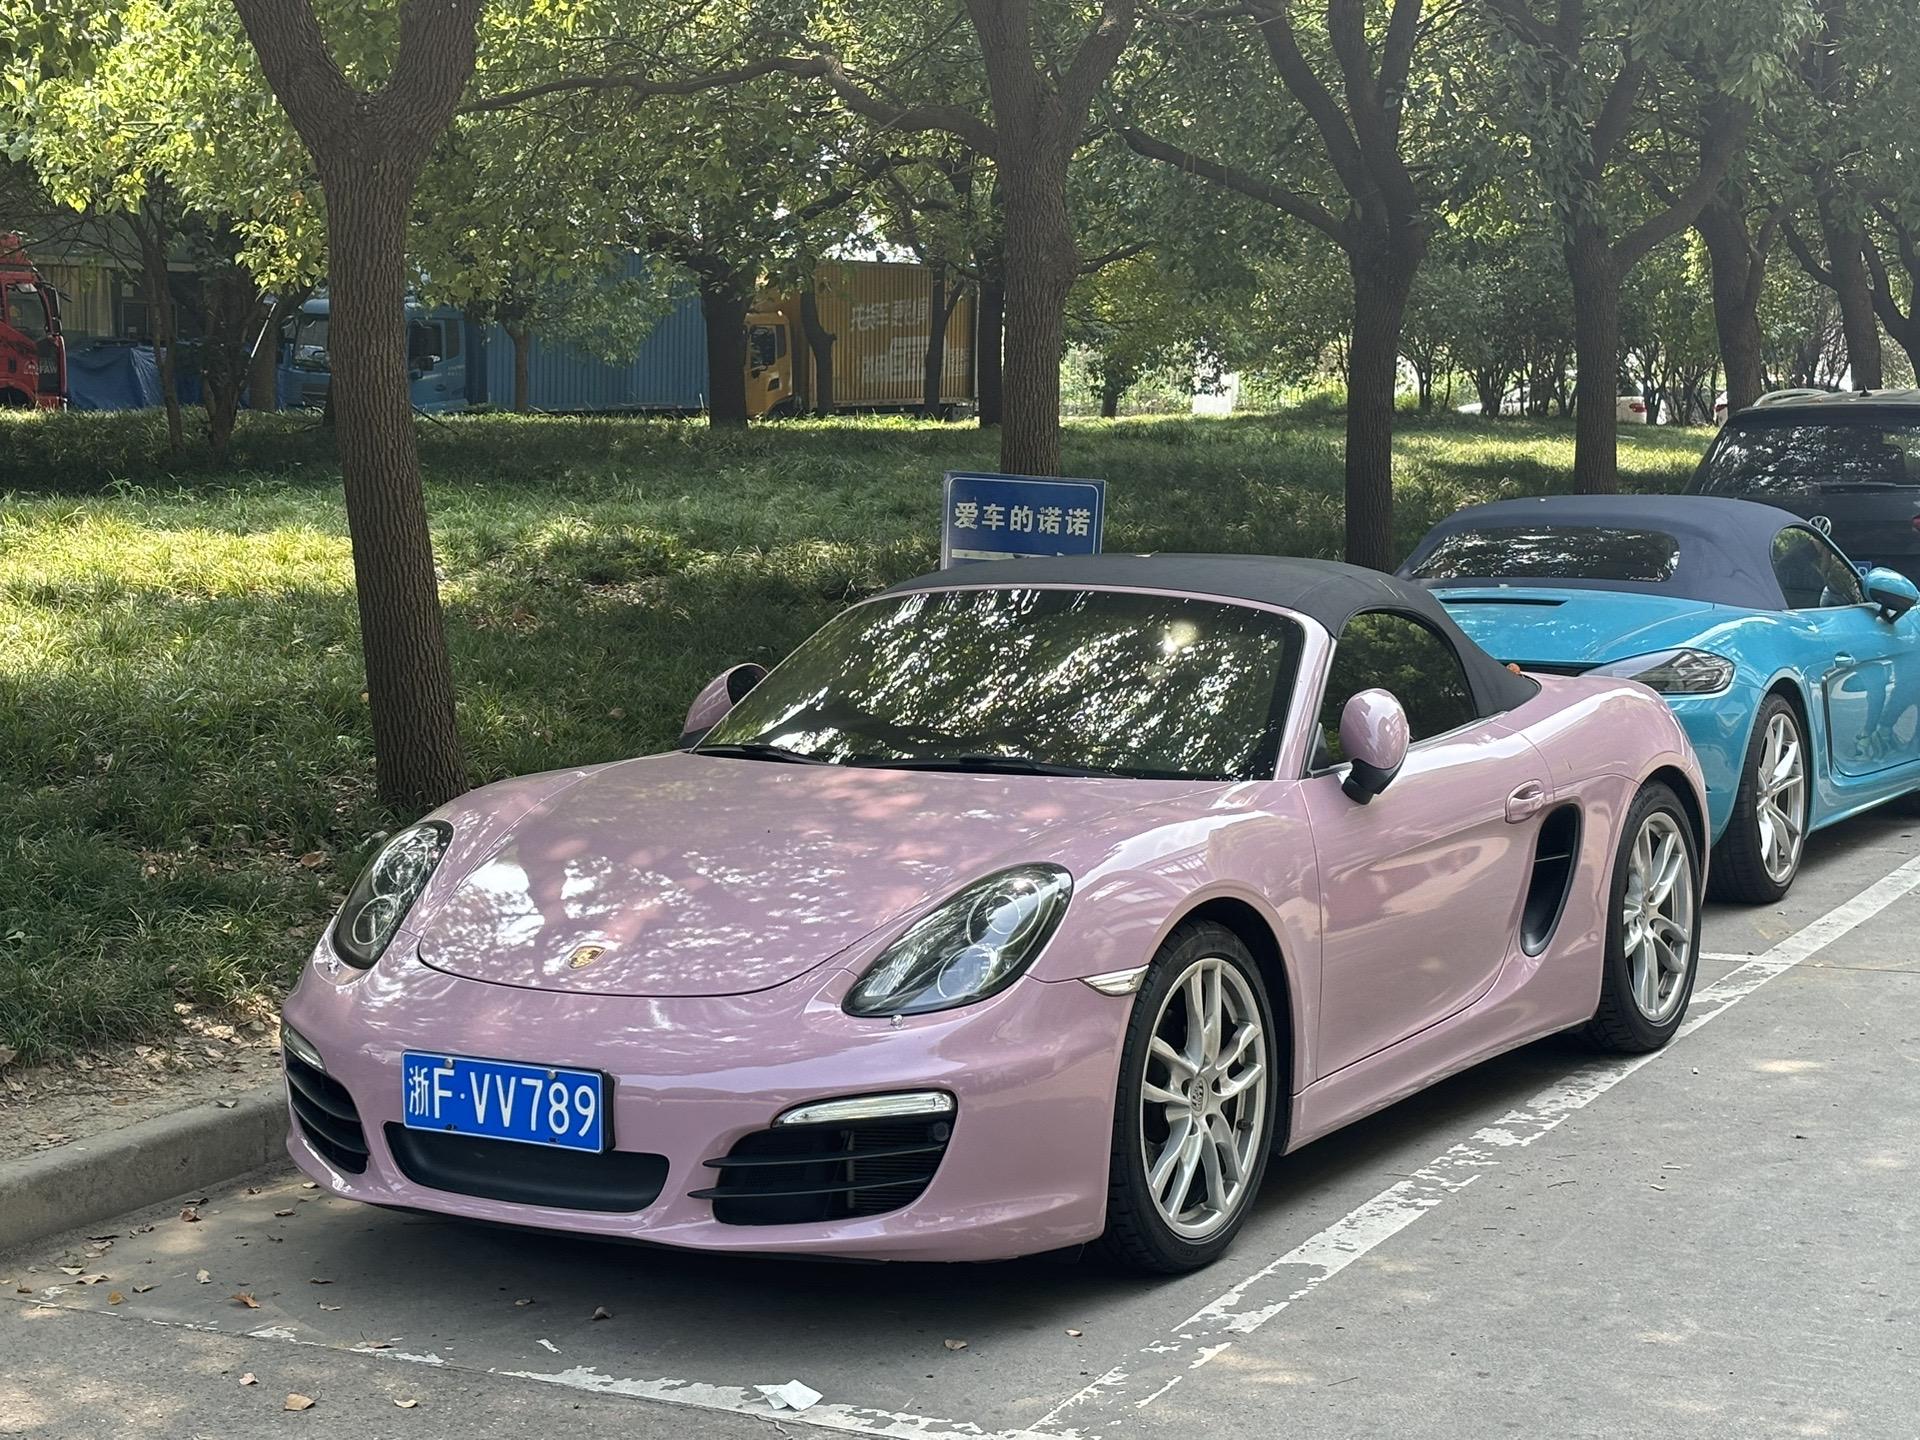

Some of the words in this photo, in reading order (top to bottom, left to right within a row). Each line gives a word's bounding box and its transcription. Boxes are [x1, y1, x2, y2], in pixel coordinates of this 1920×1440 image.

[954, 502, 1091, 537] 爱车的诺诺
[408, 1065, 597, 1138] 浙F·VV789
